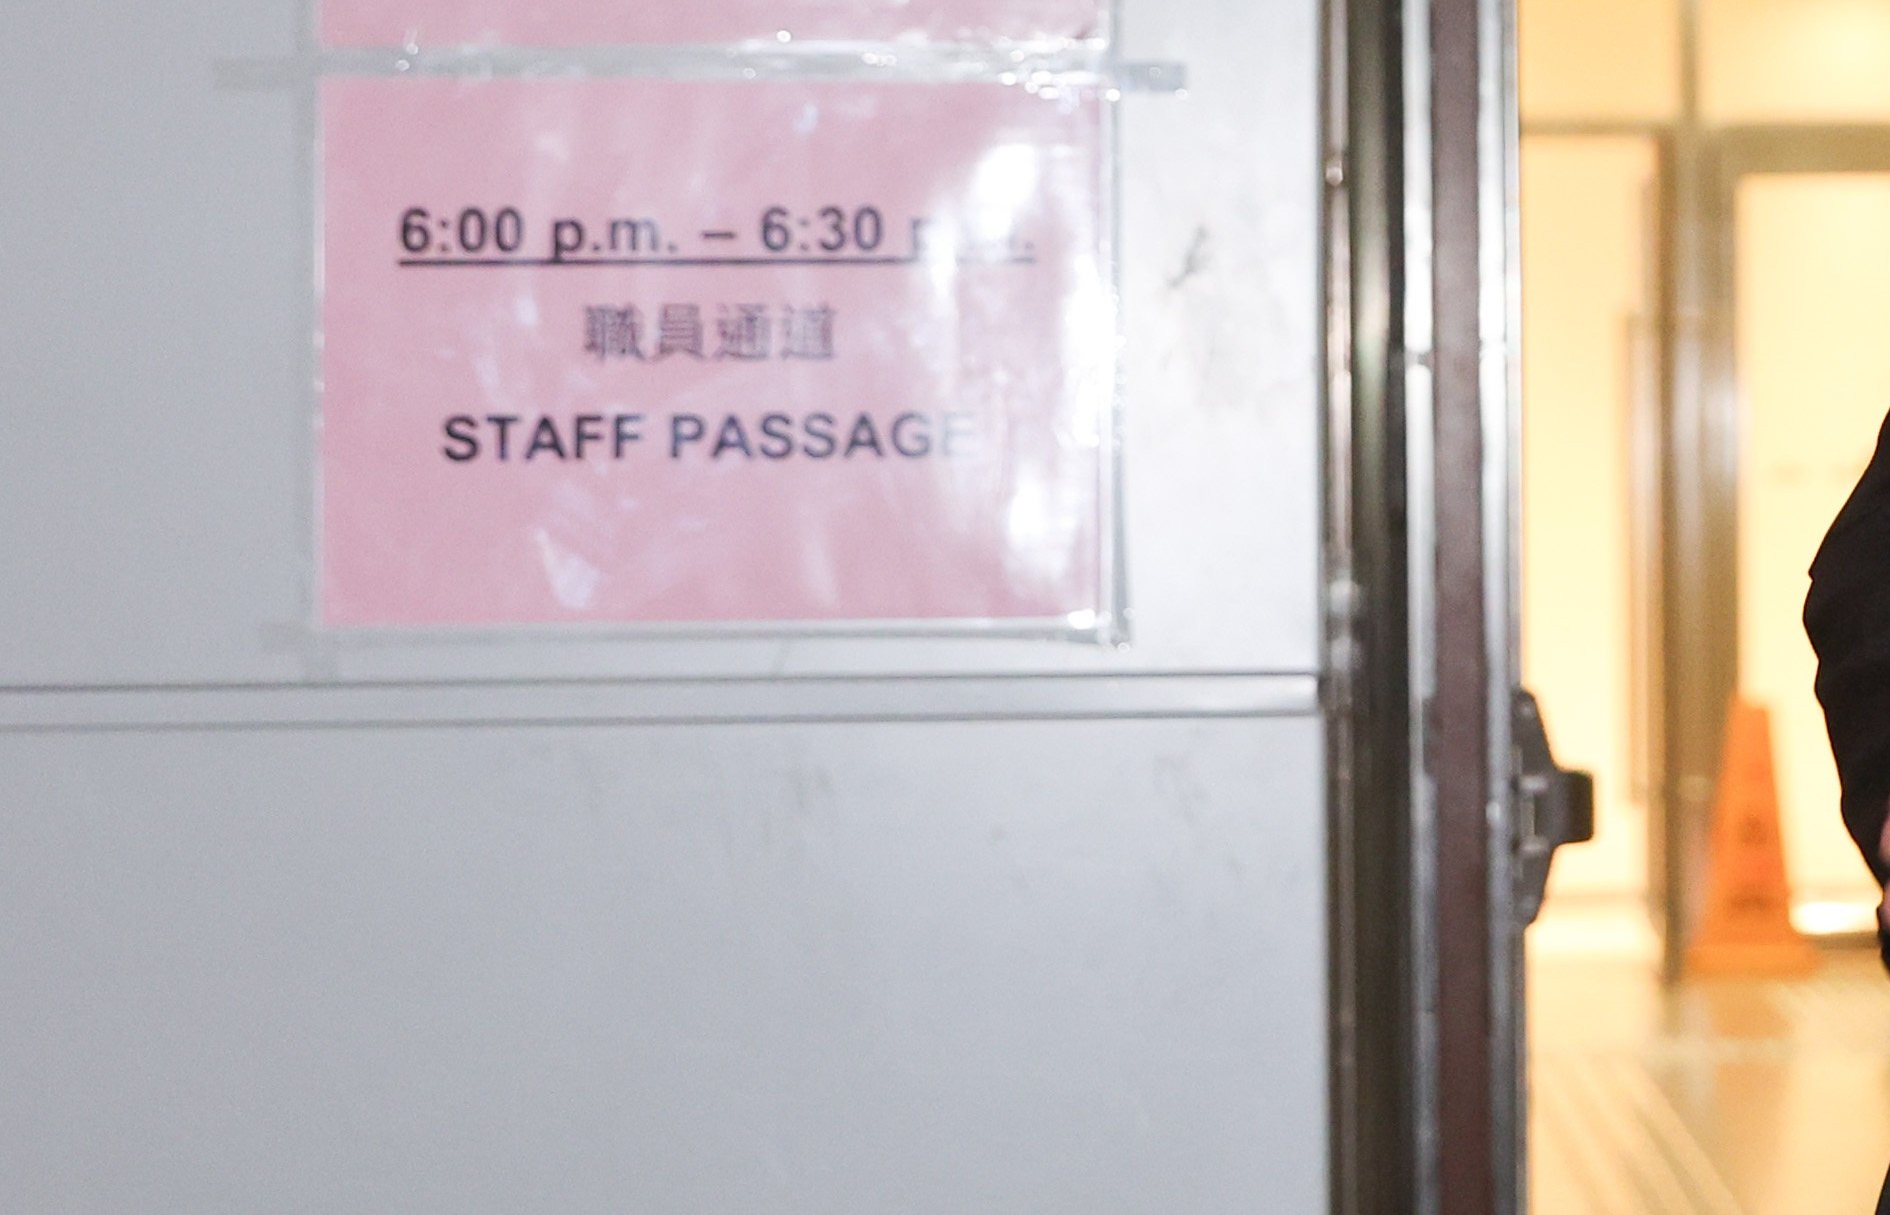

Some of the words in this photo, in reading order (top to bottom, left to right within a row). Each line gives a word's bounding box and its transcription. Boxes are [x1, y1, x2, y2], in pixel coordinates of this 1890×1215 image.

[398, 204, 526, 255] 6:00
[550, 215, 678, 261] p.m.
[758, 204, 885, 255] 6:30
[581, 302, 838, 363] 職員通道
[440, 412, 646, 464] STAFF
[669, 411, 977, 462] PASSAGE
